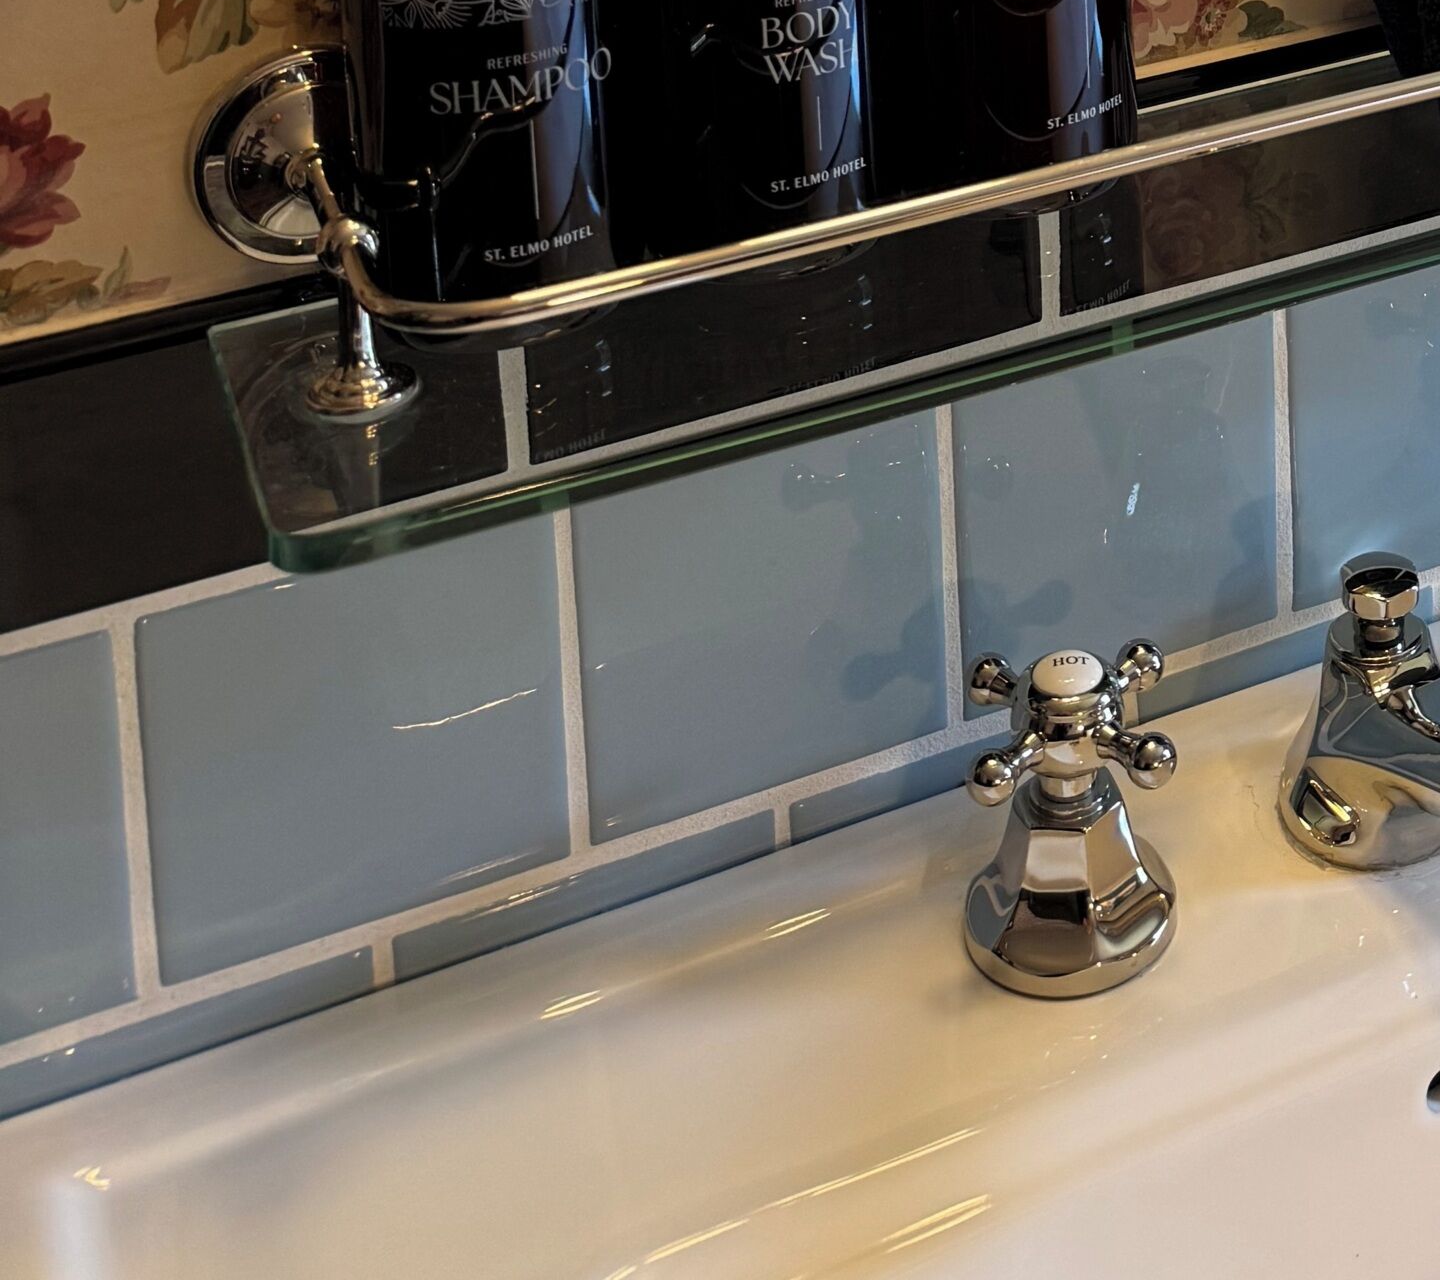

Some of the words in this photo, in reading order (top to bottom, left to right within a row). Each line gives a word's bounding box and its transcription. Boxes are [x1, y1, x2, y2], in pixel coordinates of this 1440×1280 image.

[486, 42, 568, 71] REFRESHING
[763, 38, 854, 85] WASH
[429, 46, 612, 116] SHAMPOO
[1047, 116, 1065, 130] ST.
[1067, 106, 1097, 125] ELMO
[1098, 93, 1123, 114] HOTEL
[770, 180, 791, 193] ST.
[794, 170, 830, 189] ELMO
[833, 156, 867, 179] HOTEL
[484, 248, 507, 262] ST.
[509, 238, 551, 259] ELMO
[553, 224, 595, 249] HOTEL
[1053, 655, 1090, 667] HOT
